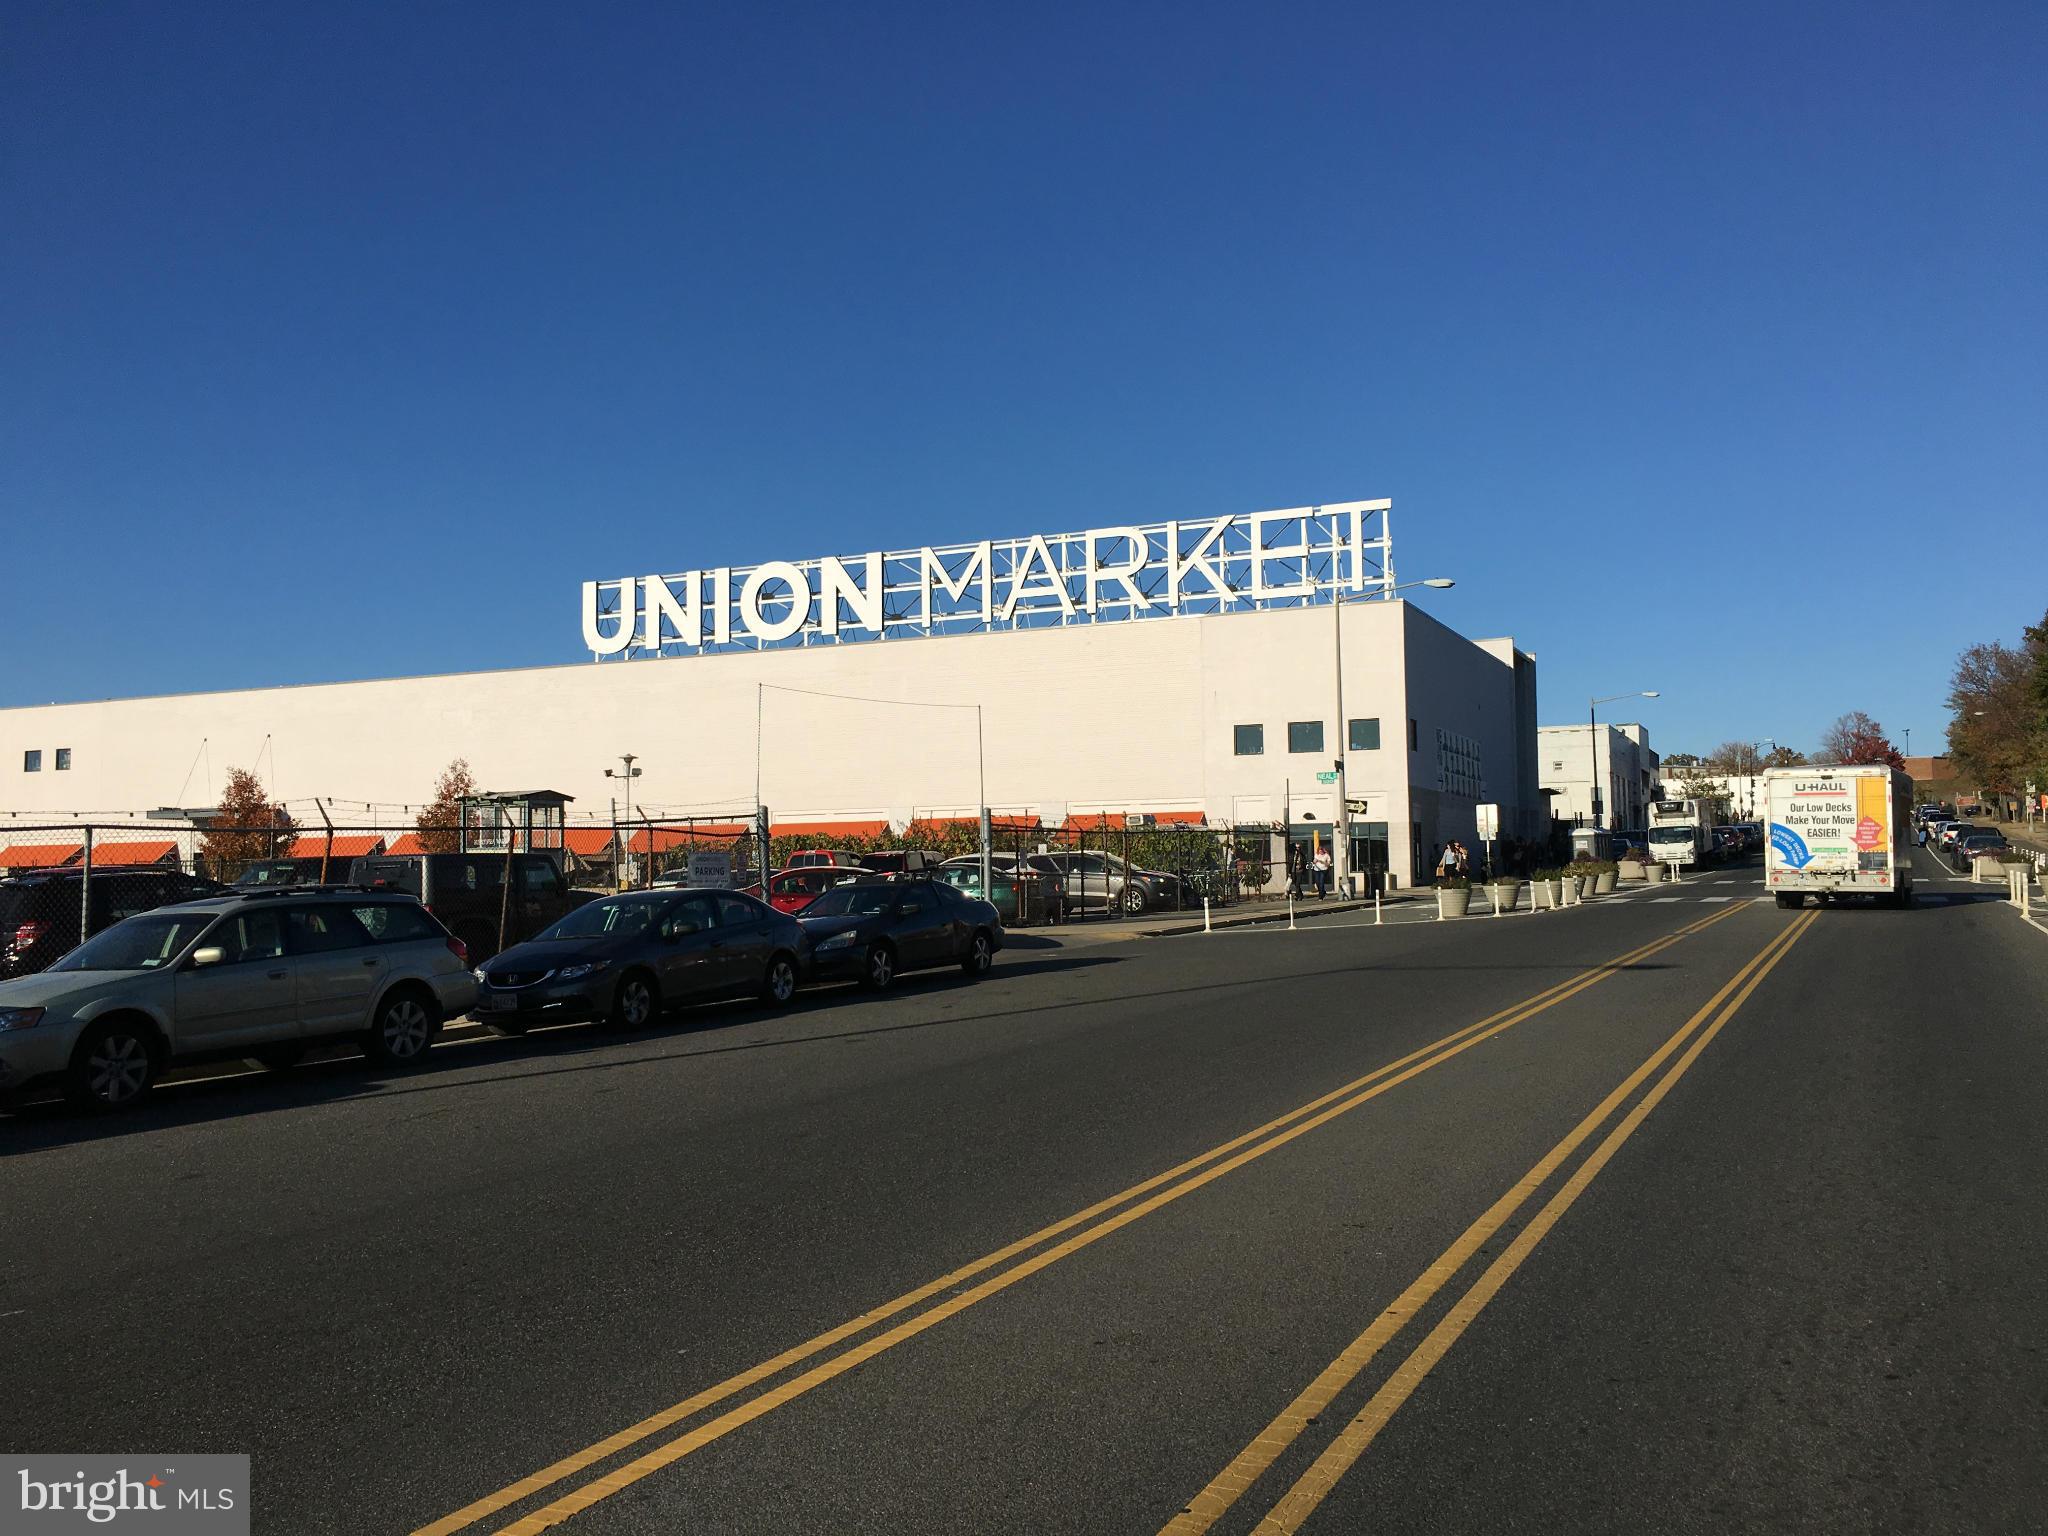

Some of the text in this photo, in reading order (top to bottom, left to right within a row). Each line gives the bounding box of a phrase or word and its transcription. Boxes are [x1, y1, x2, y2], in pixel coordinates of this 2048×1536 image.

[582, 498, 1393, 655] UNION MARKET
[1795, 783, 1847, 791] U-HAUL
[1790, 801, 1852, 812] Our Low Decks
[1785, 815, 1856, 825] Make Your Move
[1807, 828, 1841, 838] EASIER!
[695, 866, 725, 876] PARKING
